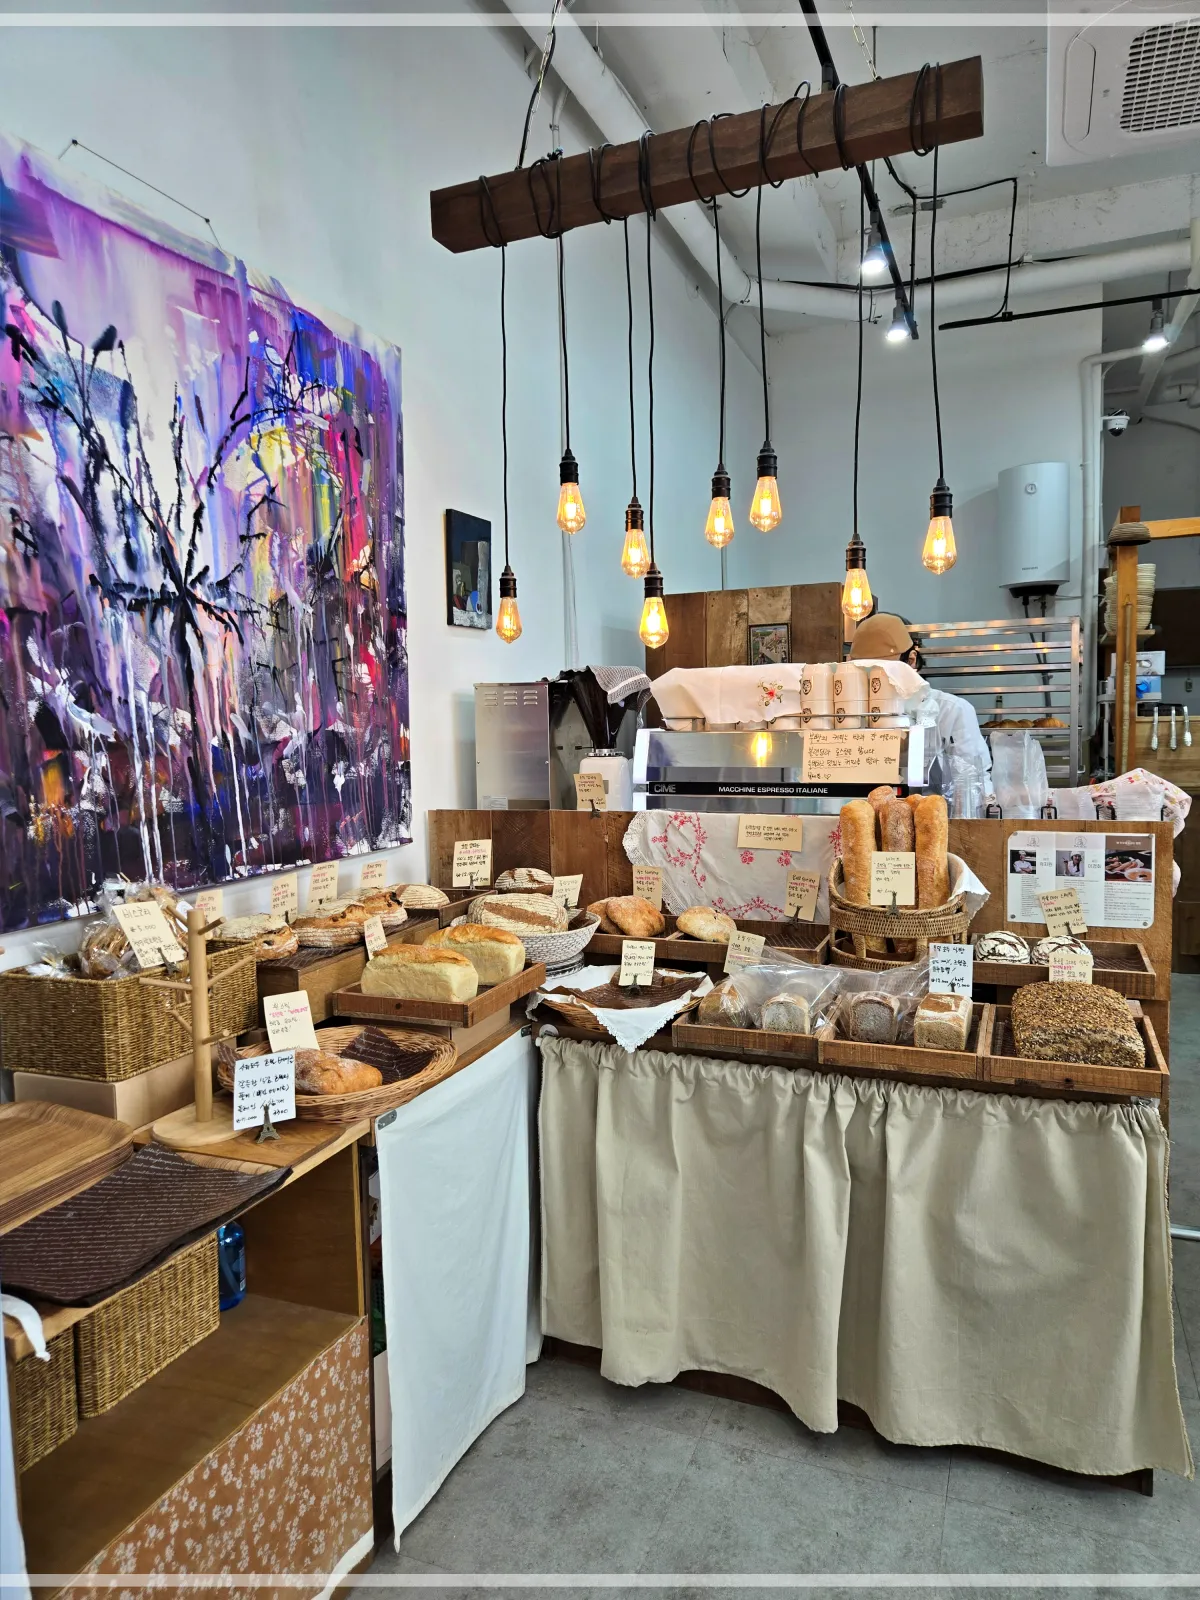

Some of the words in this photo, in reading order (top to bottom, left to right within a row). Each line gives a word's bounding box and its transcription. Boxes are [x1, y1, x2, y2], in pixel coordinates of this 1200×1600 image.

[653, 784, 677, 793] CIME
[757, 786, 795, 794] ESPRESSO
[796, 786, 829, 794] ITALIANE
[121, 906, 151, 919] 비스코티
